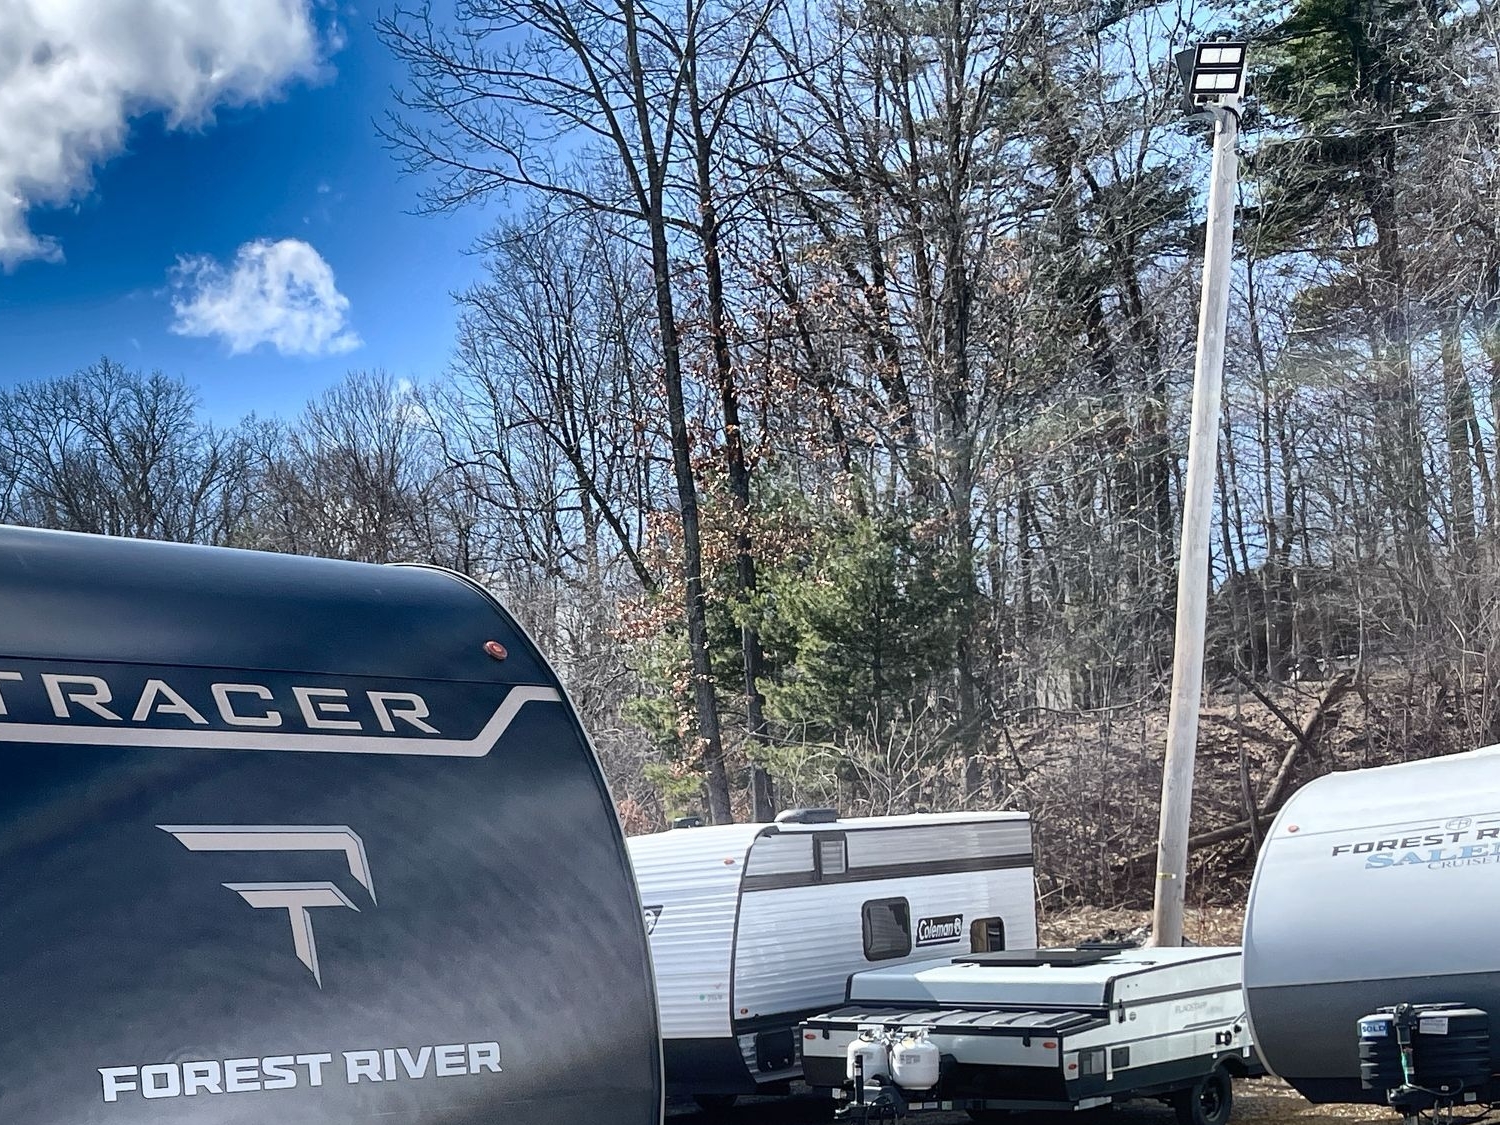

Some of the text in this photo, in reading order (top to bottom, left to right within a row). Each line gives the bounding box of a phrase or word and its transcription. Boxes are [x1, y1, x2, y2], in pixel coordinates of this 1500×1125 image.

[1331, 830, 1469, 857] FOREST
[918, 919, 954, 941] Coleman
[1362, 1025, 1386, 1033] SOLD
[98, 1041, 503, 1102] FOREST RIVER
